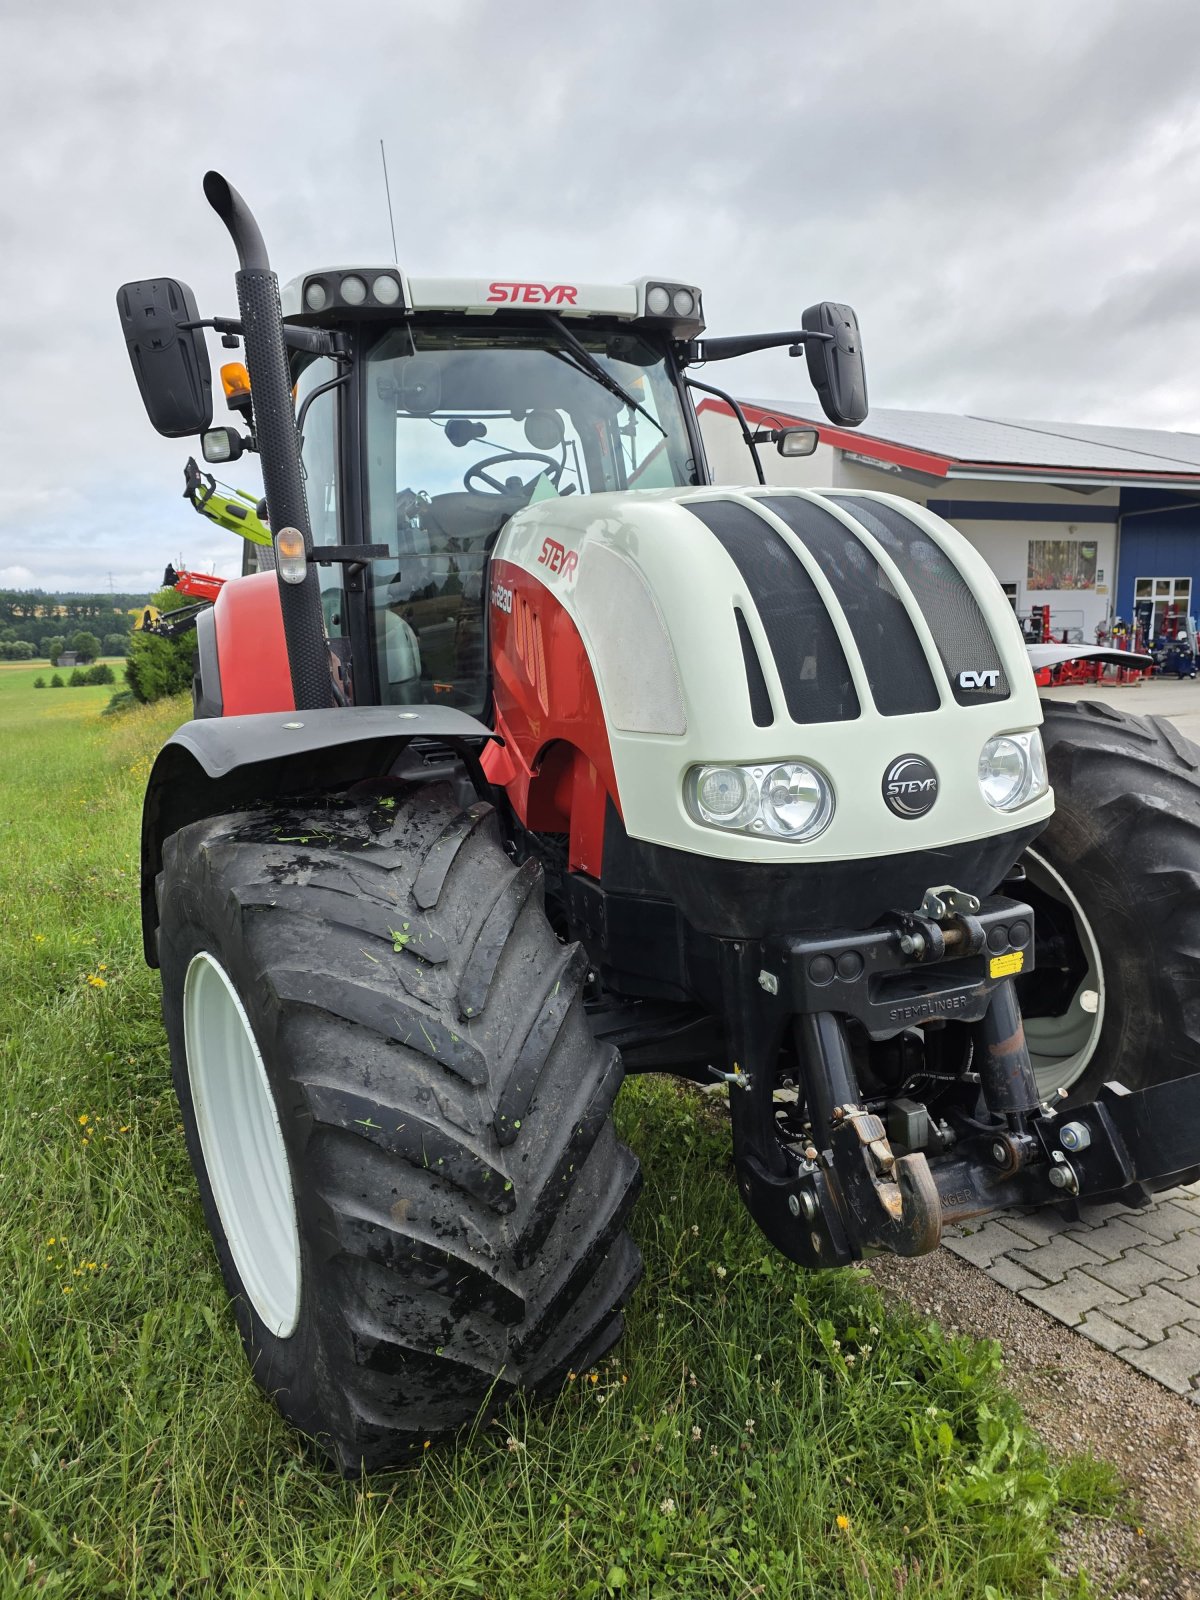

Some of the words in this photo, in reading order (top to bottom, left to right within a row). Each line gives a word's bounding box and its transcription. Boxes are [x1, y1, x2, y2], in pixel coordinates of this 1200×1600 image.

[486, 282, 577, 304] STEYR
[537, 537, 578, 582] STEYR
[497, 584, 512, 614] 6230
[959, 670, 999, 688] CVT
[887, 778, 936, 796] STEYR
[940, 1188, 972, 1208] NGER
